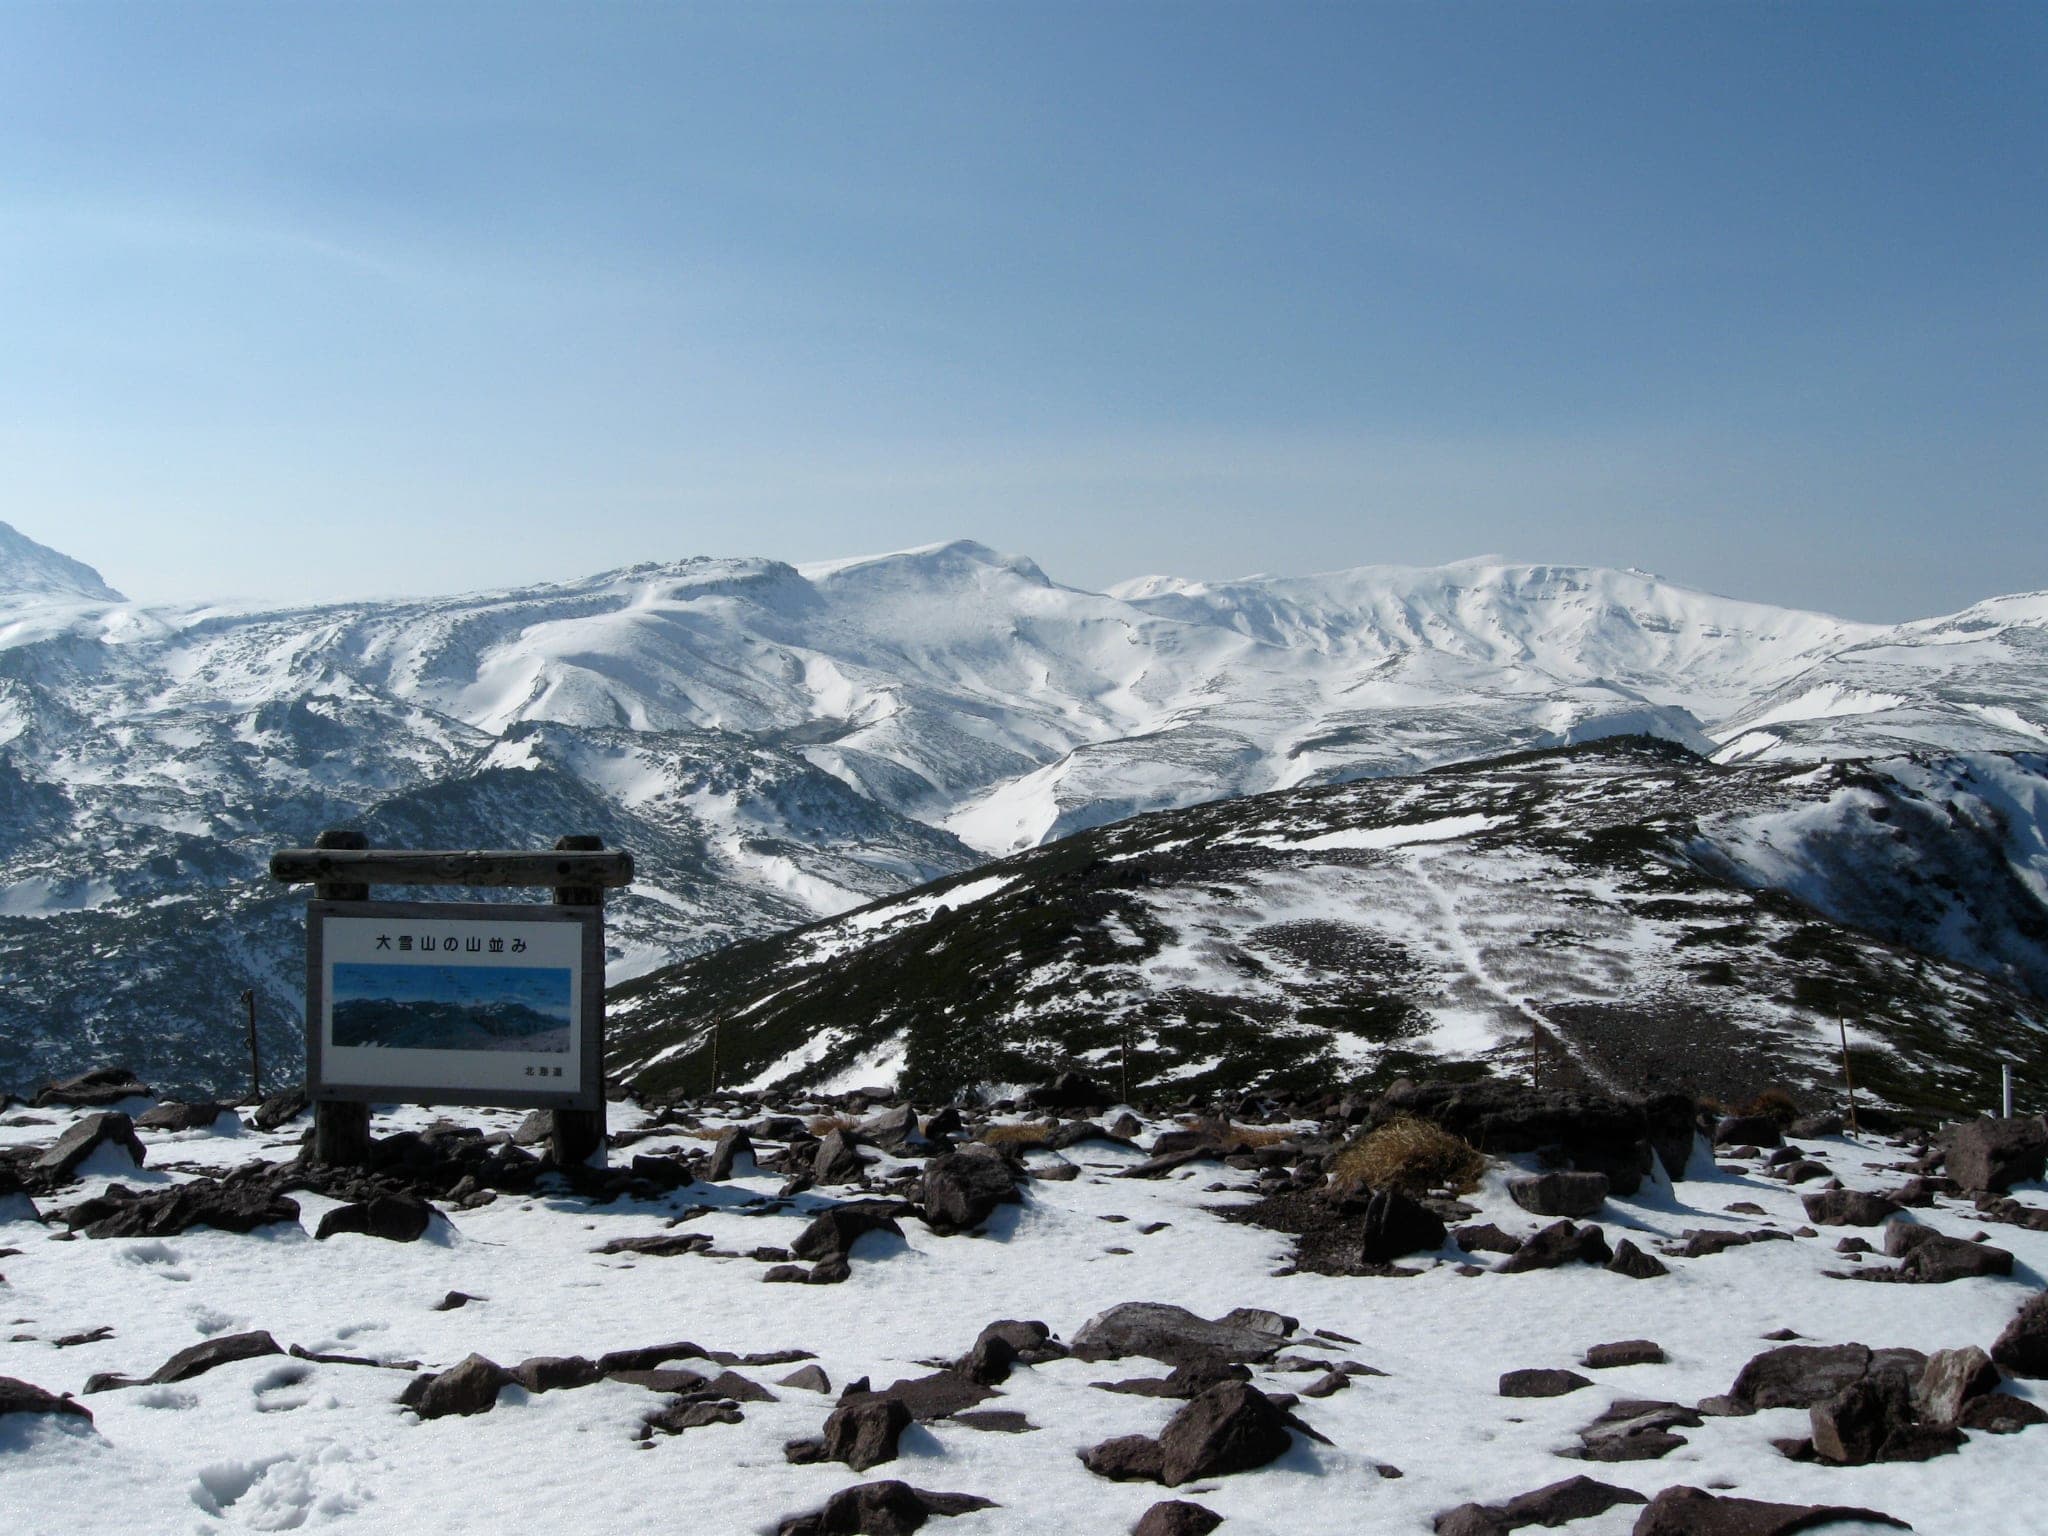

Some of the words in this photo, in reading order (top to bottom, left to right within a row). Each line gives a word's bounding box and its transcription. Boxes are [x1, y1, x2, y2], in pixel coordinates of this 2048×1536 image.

[376, 934, 527, 953] 大雪山の山並み
